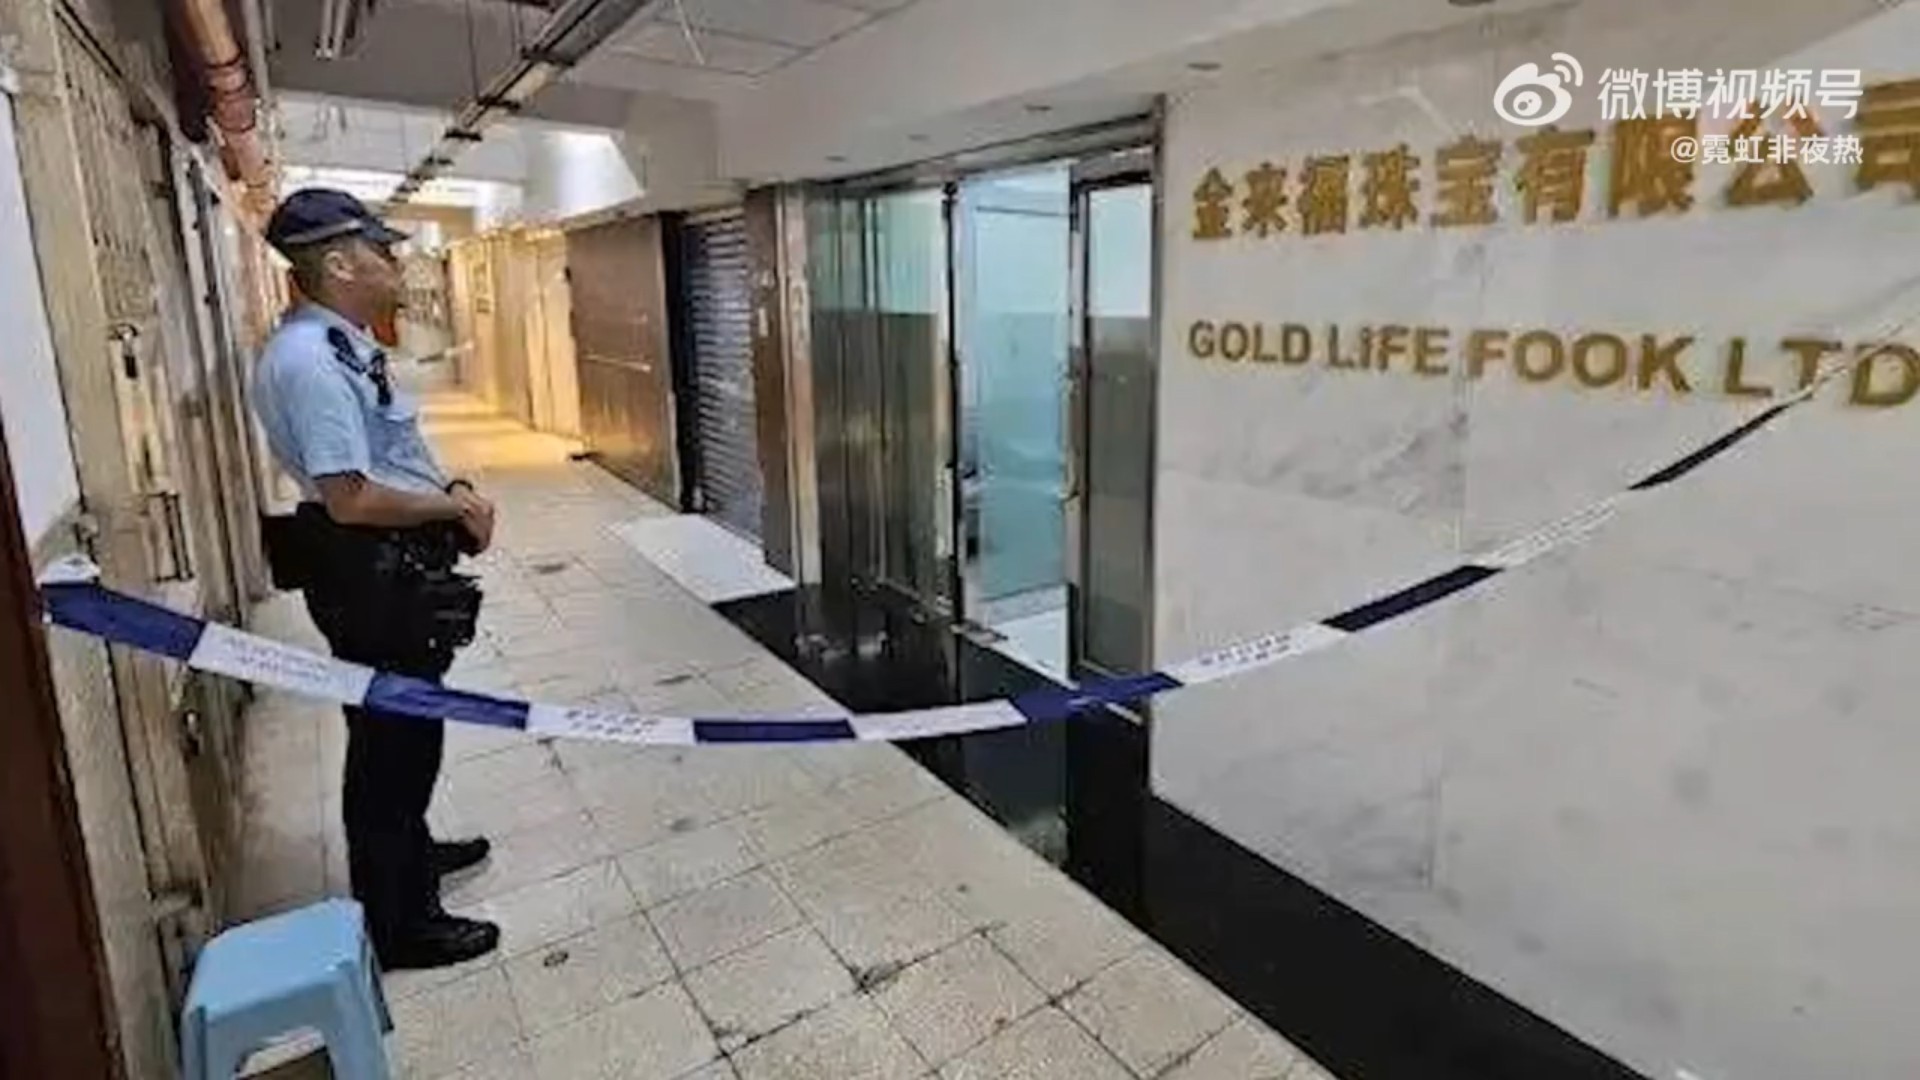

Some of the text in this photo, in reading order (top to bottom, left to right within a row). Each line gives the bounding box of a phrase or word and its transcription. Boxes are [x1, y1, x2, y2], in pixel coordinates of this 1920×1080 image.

[1189, 319, 1311, 364] GOLD
[1466, 328, 1695, 394] FOOK
[1723, 335, 1920, 408] LTD
